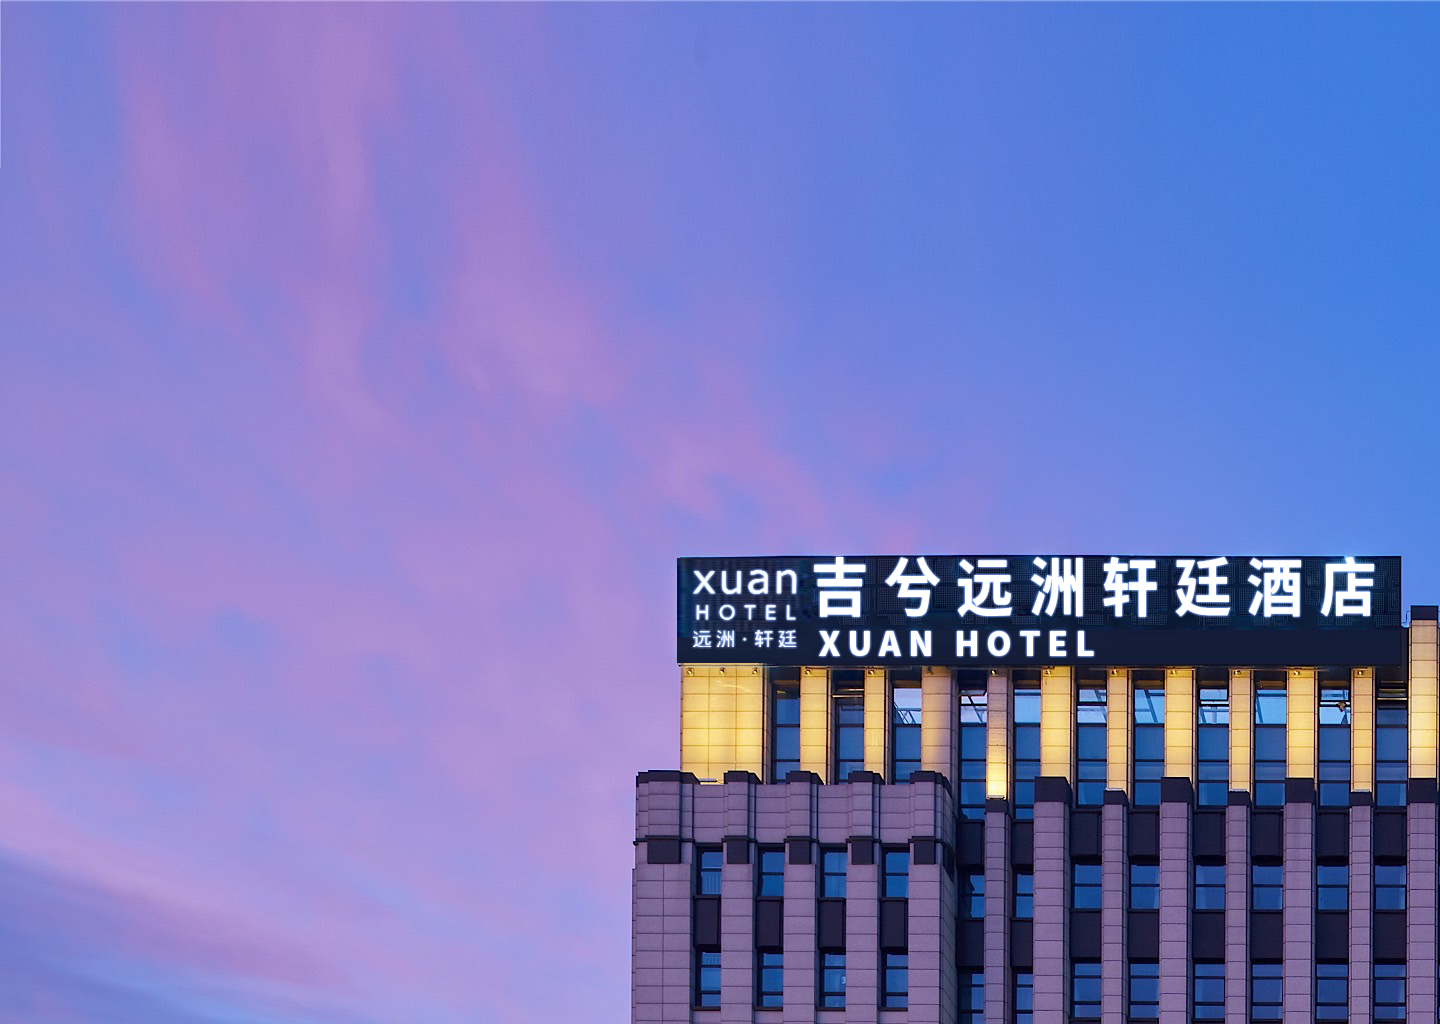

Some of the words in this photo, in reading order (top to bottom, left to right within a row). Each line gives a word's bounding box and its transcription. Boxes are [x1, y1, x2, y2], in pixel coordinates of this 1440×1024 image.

[693, 569, 798, 595] xuan
[813, 557, 1376, 618] 吉兮远洲轩廷酒店
[695, 604, 797, 621] HOTEL
[818, 630, 933, 657] XUAN
[956, 630, 1096, 657] HOTEL
